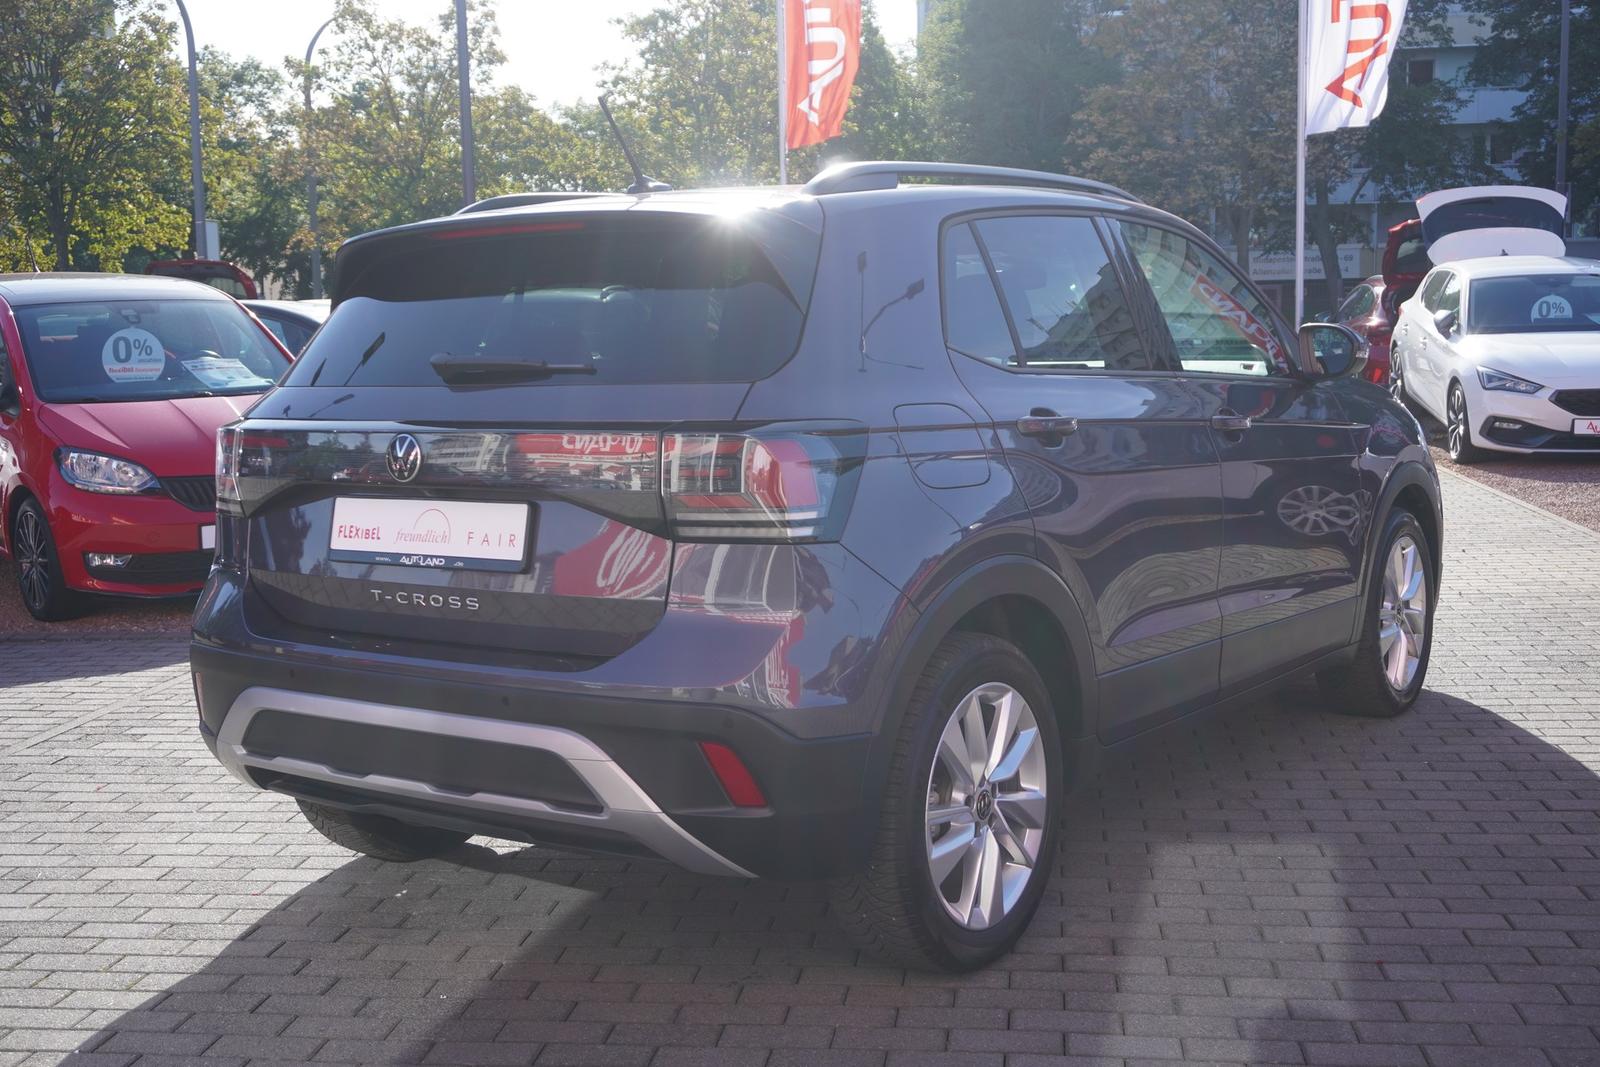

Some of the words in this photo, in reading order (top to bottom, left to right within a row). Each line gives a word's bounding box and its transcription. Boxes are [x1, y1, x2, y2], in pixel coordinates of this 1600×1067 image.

[797, 0, 846, 128] AUT
[1538, 300, 1565, 317] 0%
[112, 335, 153, 363] 0%
[337, 524, 381, 541] FLEXIBEL
[393, 528, 449, 545] freundlich
[466, 531, 517, 548] FAIR
[399, 555, 446, 567] AUTOLAND
[370, 589, 480, 611] T-CROSS
